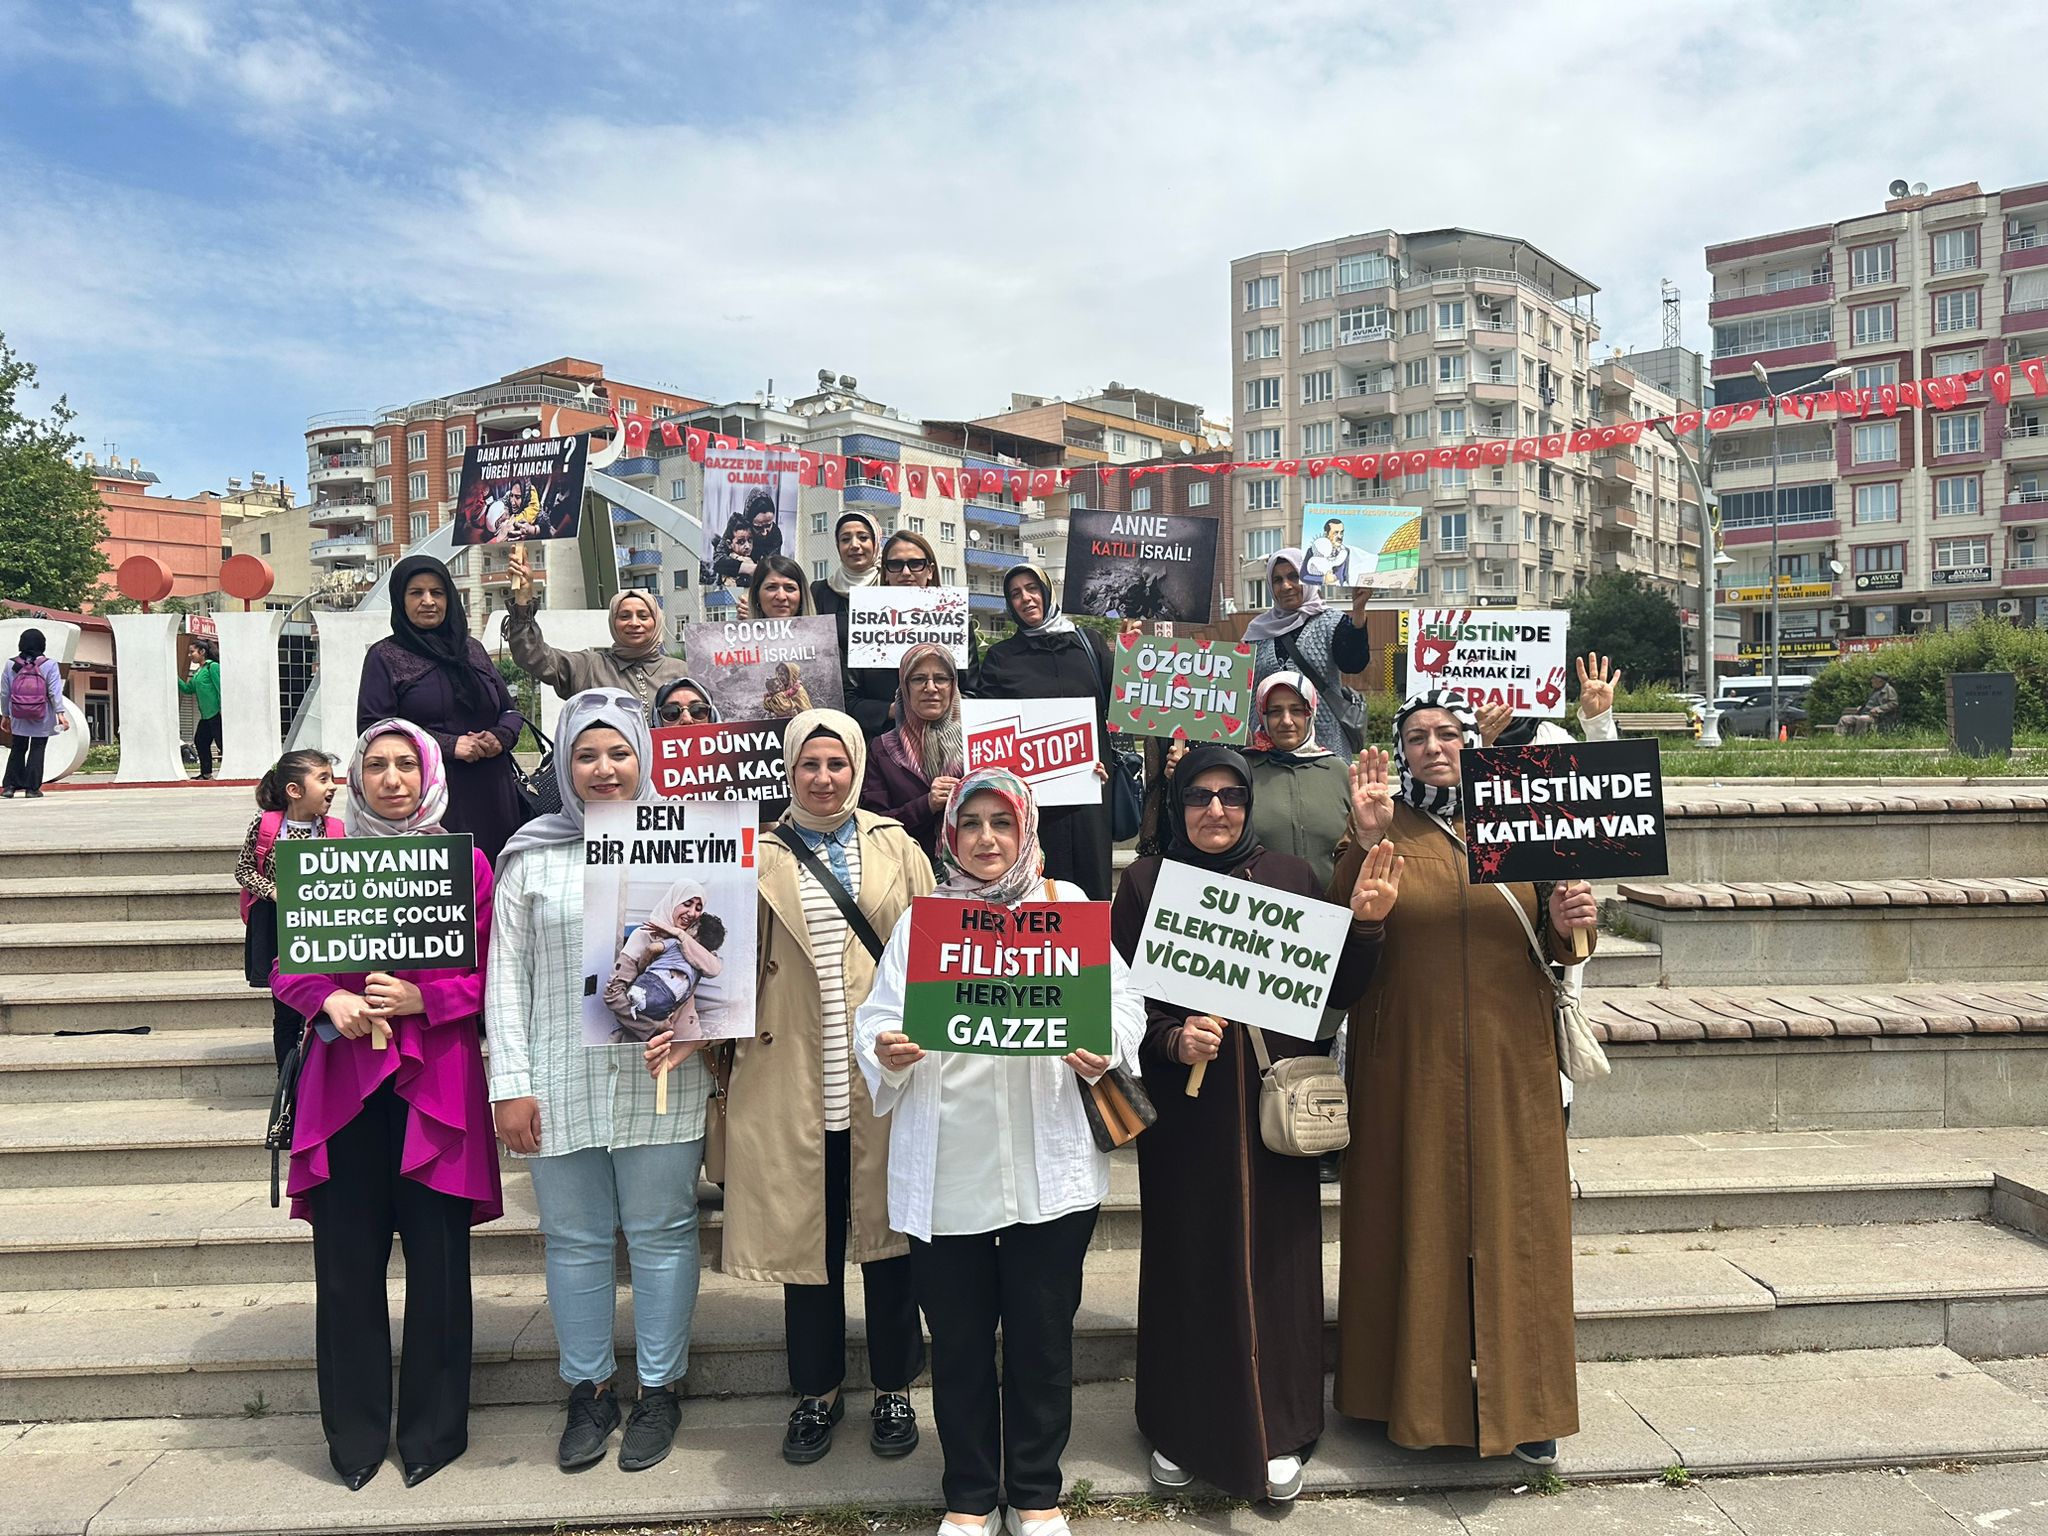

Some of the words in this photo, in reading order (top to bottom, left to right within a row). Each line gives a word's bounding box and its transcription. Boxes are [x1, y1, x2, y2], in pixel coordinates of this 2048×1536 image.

[1352, 327, 1382, 336] AVUKAT
[477, 448, 499, 462] DAHA
[502, 446, 519, 461] KAÇ
[521, 439, 560, 458] ANNENİN
[563, 436, 577, 473] ?
[481, 462, 510, 480] YÜREĞİ
[512, 460, 554, 477] YANACAK
[705, 457, 763, 471] GAZZE'DE
[766, 460, 799, 472] ANNE
[727, 471, 770, 484] OLMAK
[1110, 514, 1168, 538] ANNE
[1092, 539, 1136, 558] KATİLİ
[1139, 540, 1191, 562] İSRAİL!
[1871, 573, 1899, 581] AVUKAT
[1953, 568, 1984, 576] AVUKAT
[910, 610, 966, 628] SAVAŞ
[724, 619, 795, 645] ÇOCUK
[852, 630, 965, 646] SUÇLUSUDUR
[714, 646, 761, 667] KATİLİ
[764, 643, 816, 663] İSRAİL!
[1137, 644, 1233, 679] ÖZGÜR
[1457, 646, 1516, 662] KATİLİN
[1443, 665, 1509, 679] PARMAK
[1511, 665, 1530, 679] İZİ
[1124, 678, 1237, 714] FİLİSTİN
[662, 737, 692, 759] EY
[700, 731, 782, 756] DÜNYA
[971, 733, 1015, 766] #SAY
[1019, 729, 1087, 772] STOP!
[663, 763, 733, 788] DAHA
[738, 758, 786, 781] KAÇ
[636, 805, 685, 831] BEN
[1477, 815, 1596, 845] KATLİAM
[1600, 814, 1657, 838] VAR
[299, 847, 449, 875] DÜNYANIN
[586, 833, 625, 865] BİR
[298, 879, 357, 901] GÖZÜ
[362, 878, 453, 899] ÖNÜNDE
[286, 907, 388, 928] BİNLERCE
[393, 904, 467, 927] ÇOCUK
[961, 908, 1005, 933] HER
[1012, 911, 1062, 932] YER
[1199, 885, 1240, 915] SU
[1247, 896, 1305, 934] YOK
[289, 930, 464, 963] ÖLDÜRÜLDÜ
[1154, 908, 1275, 959] ELEKTRİK
[1280, 941, 1331, 974] YOK
[939, 937, 1079, 977] FİLİSTİN
[1145, 939, 1250, 989] VİCDAN
[1258, 970, 1323, 1009] YOK!
[956, 982, 1008, 1007] HER
[1010, 985, 1062, 1007] YER
[947, 1014, 1068, 1048] GAZZE
